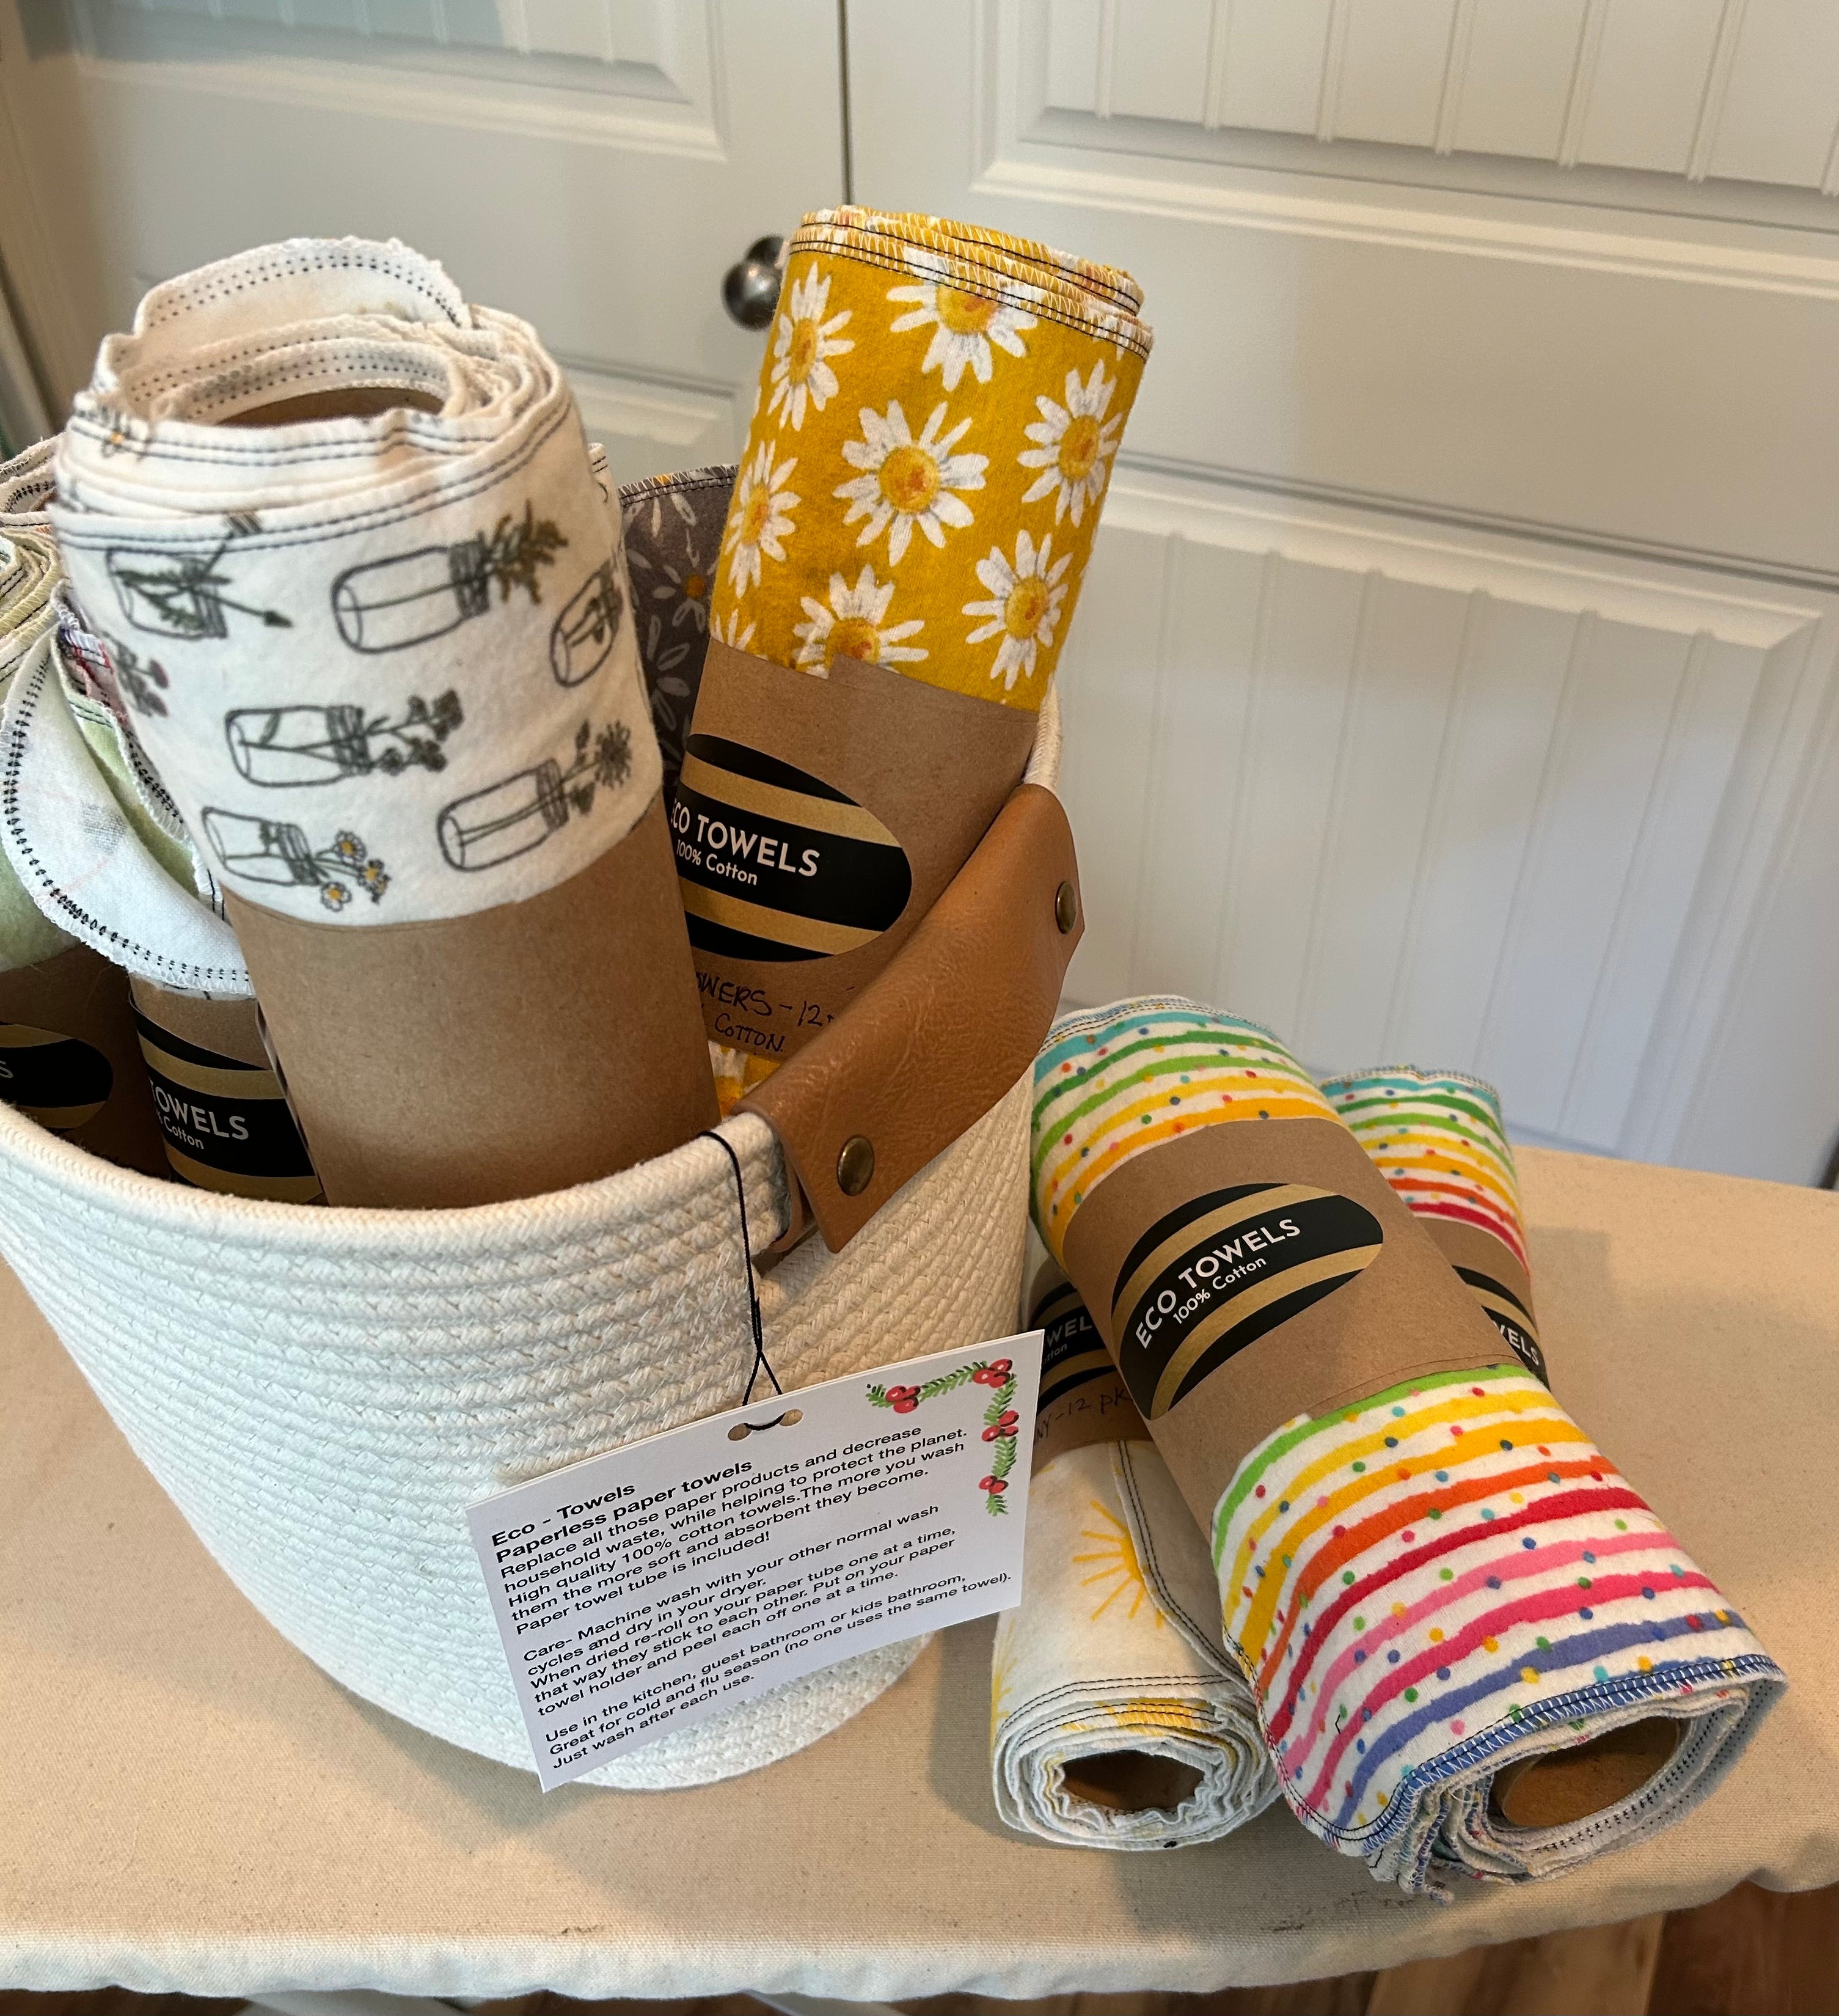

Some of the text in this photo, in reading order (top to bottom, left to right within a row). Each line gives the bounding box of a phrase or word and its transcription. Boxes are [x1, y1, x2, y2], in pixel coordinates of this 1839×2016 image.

[676, 838, 758, 885] 100% Cotton
[697, 813, 821, 878] TOWELS
[163, 1115, 205, 1149] Cotton
[1046, 1315, 1093, 1347] WEL
[1135, 1219, 1301, 1349] ECO TOWELS
[1172, 1258, 1267, 1324] 100% Cotton
[491, 1523, 535, 1547] Eco
[556, 1484, 635, 1520] Towels
[495, 1461, 753, 1564] Paperless paper towels
[500, 1427, 921, 1579] Replace all those paper products and decrease
[503, 1428, 967, 1594] household waste, while helping to protect the planet.
[508, 1585, 550, 1608] High
[555, 1559, 616, 1588] quality
[621, 1537, 672, 1564] 100%
[678, 1516, 735, 1542] cotton
[837, 1467, 881, 1487] more
[885, 1456, 916, 1475] you
[920, 1442, 964, 1461] wash
[511, 1468, 929, 1621] them the more soft and absorbent they become.
[516, 1530, 770, 1635] Paper towel tube is included!
[523, 1505, 938, 1662] Care- Machine wash with your other normal wash
[527, 1577, 767, 1676] cycles and dry in your dryer.
[529, 1528, 956, 1689] When dried re-roll on your paper tube one at a time,
[534, 1538, 956, 1703] that way they stick to each other. Put on your paper
[537, 1571, 898, 1716] towel holder and peel each off one at a time.
[545, 1575, 965, 1742] Use in the kitchen, guest bathroom or kids bathroom,
[549, 1572, 1011, 1755] Great for cold and flu season (no one uses the same towel).
[552, 1674, 755, 1769] Just wash after each use.
